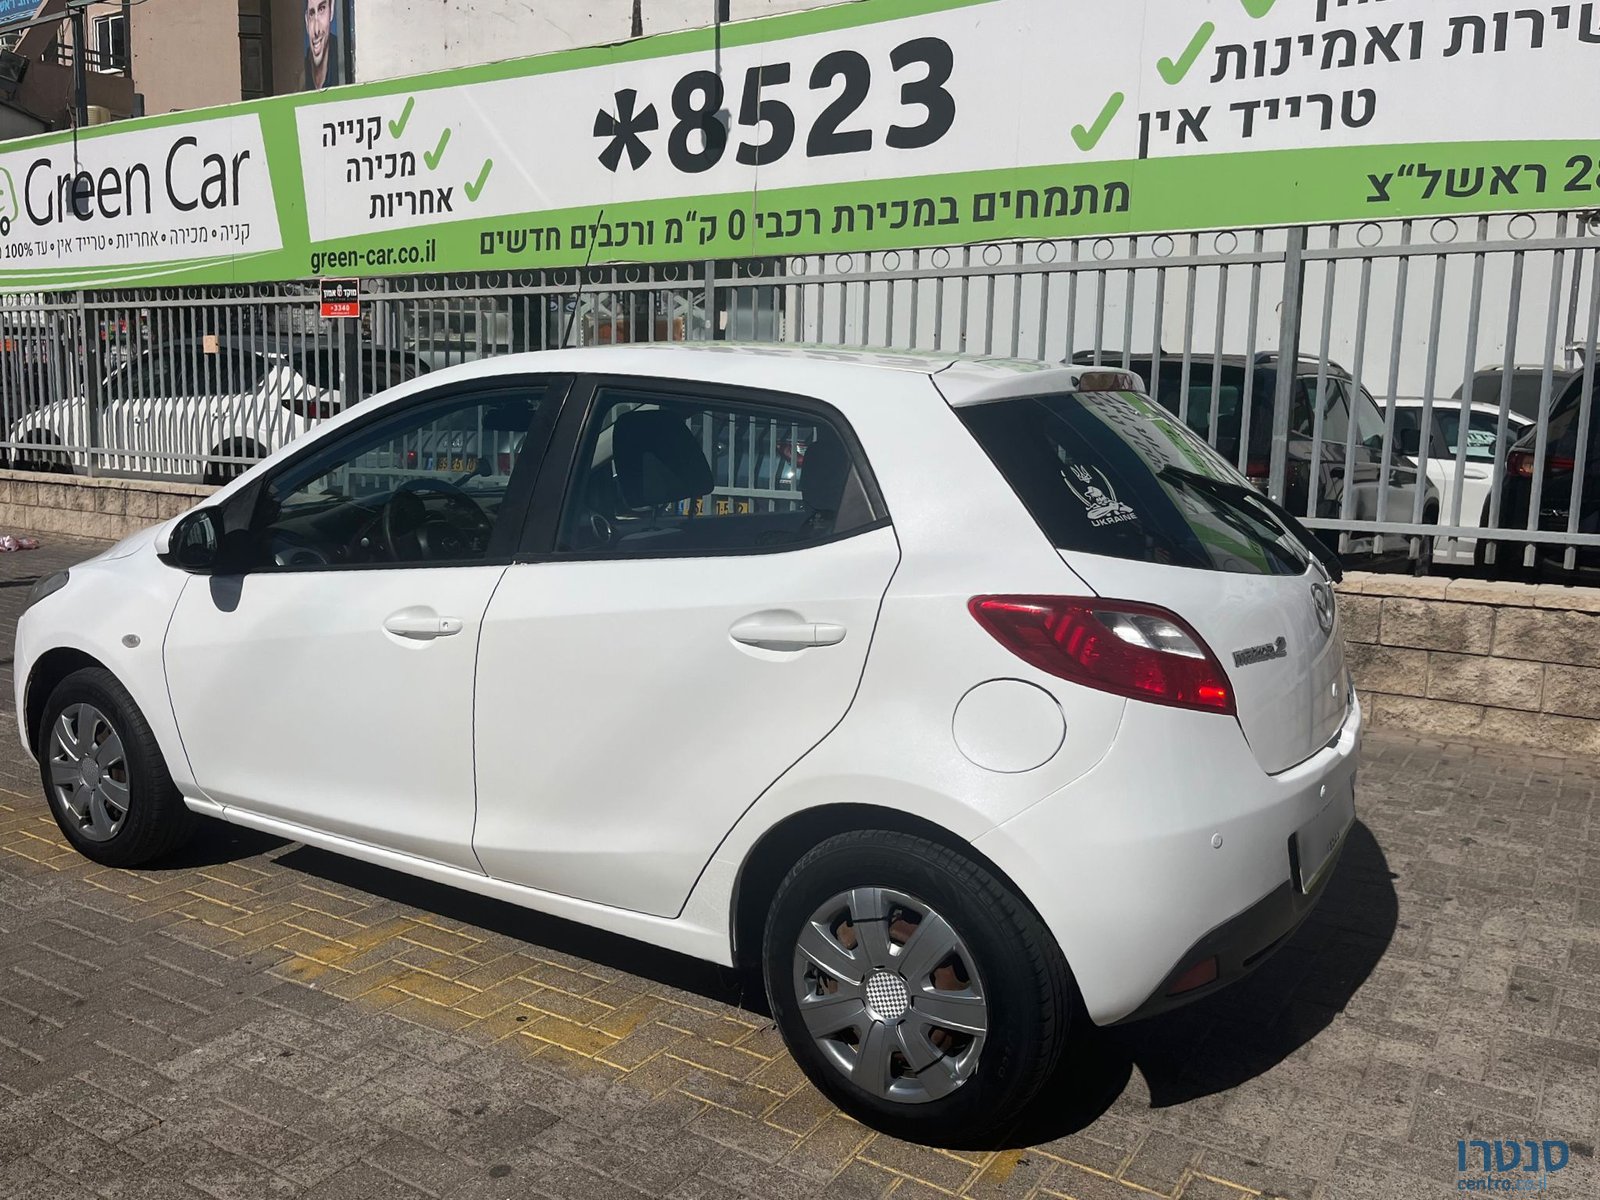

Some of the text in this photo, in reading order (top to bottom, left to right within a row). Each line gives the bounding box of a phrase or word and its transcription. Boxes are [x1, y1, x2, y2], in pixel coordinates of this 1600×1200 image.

[1210, 21, 1424, 84] ואמינות
[322, 116, 382, 149] קנייה
[1138, 89, 1377, 160] טרייד אין
[25, 136, 251, 227] Green Car
[346, 151, 417, 183] מכירה
[1563, 154, 1600, 192] 2
[369, 186, 454, 220] אחריות
[831, 195, 960, 234] במכירת
[972, 182, 1130, 223] מתמחים
[5, 223, 250, 259] קניה מכירה אחריות טרייד אין עד 100%
[480, 225, 561, 255] חדשים
[570, 220, 654, 250] ורכבים
[728, 208, 746, 241] 0
[754, 208, 821, 239] רכבי
[310, 238, 436, 275] green-car.co.il
[1091, 512, 1138, 528] UKRAINE
